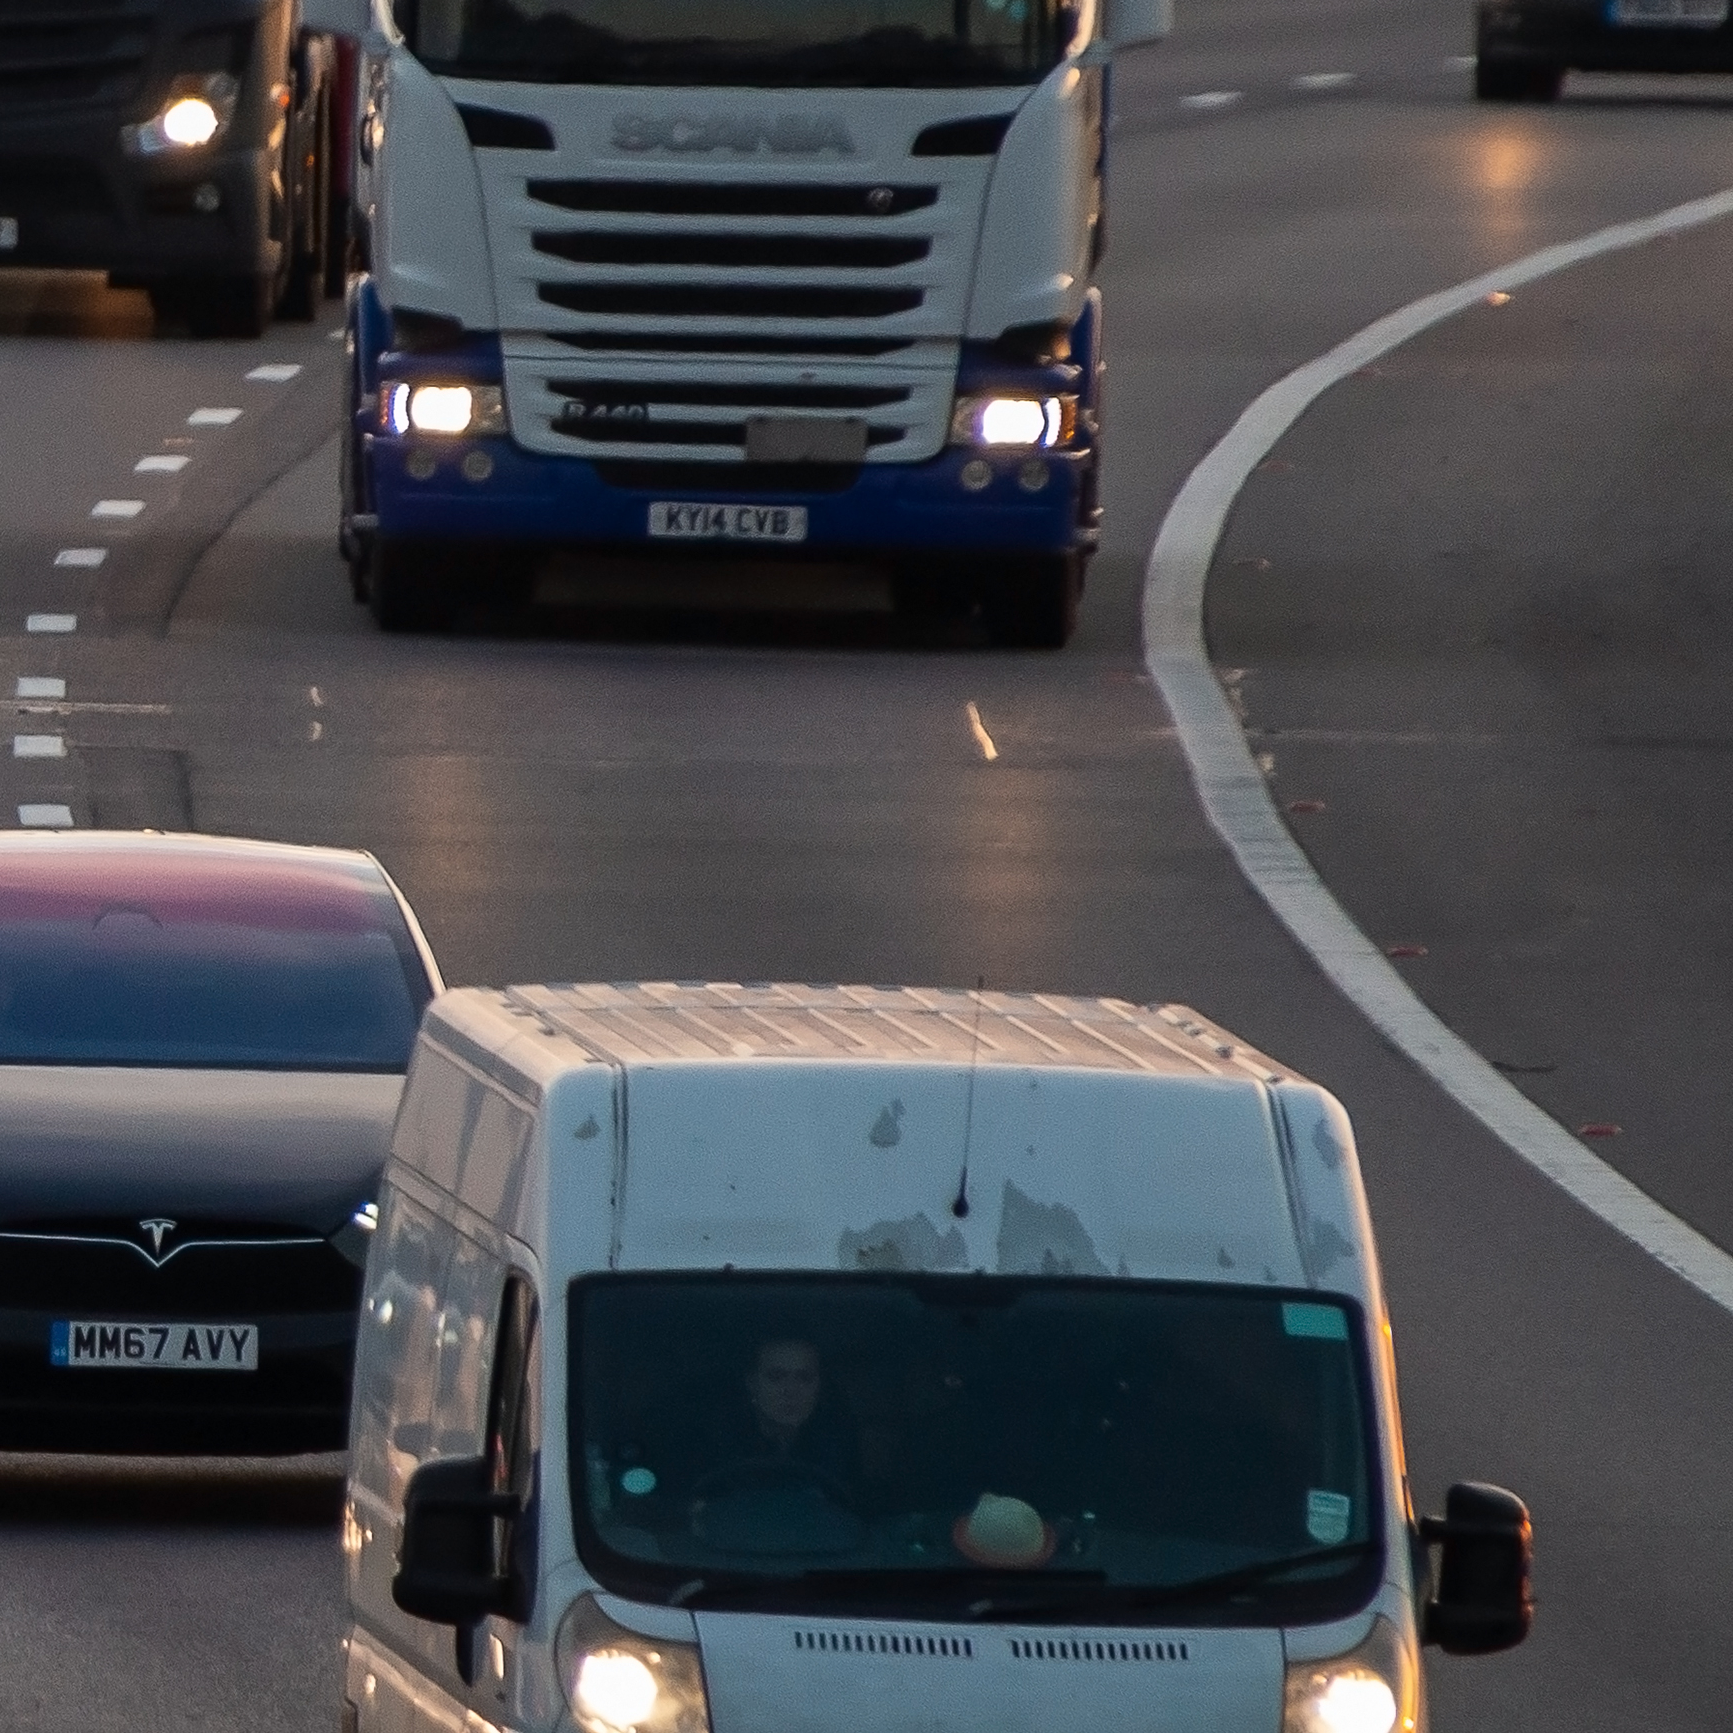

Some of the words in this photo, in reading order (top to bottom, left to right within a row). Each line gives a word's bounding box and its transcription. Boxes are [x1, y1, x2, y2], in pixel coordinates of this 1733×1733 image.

[611, 113, 856, 153] SCANIA
[666, 506, 727, 533] KY14
[74, 1325, 170, 1361] MM67
[181, 1328, 251, 1364] AVY
